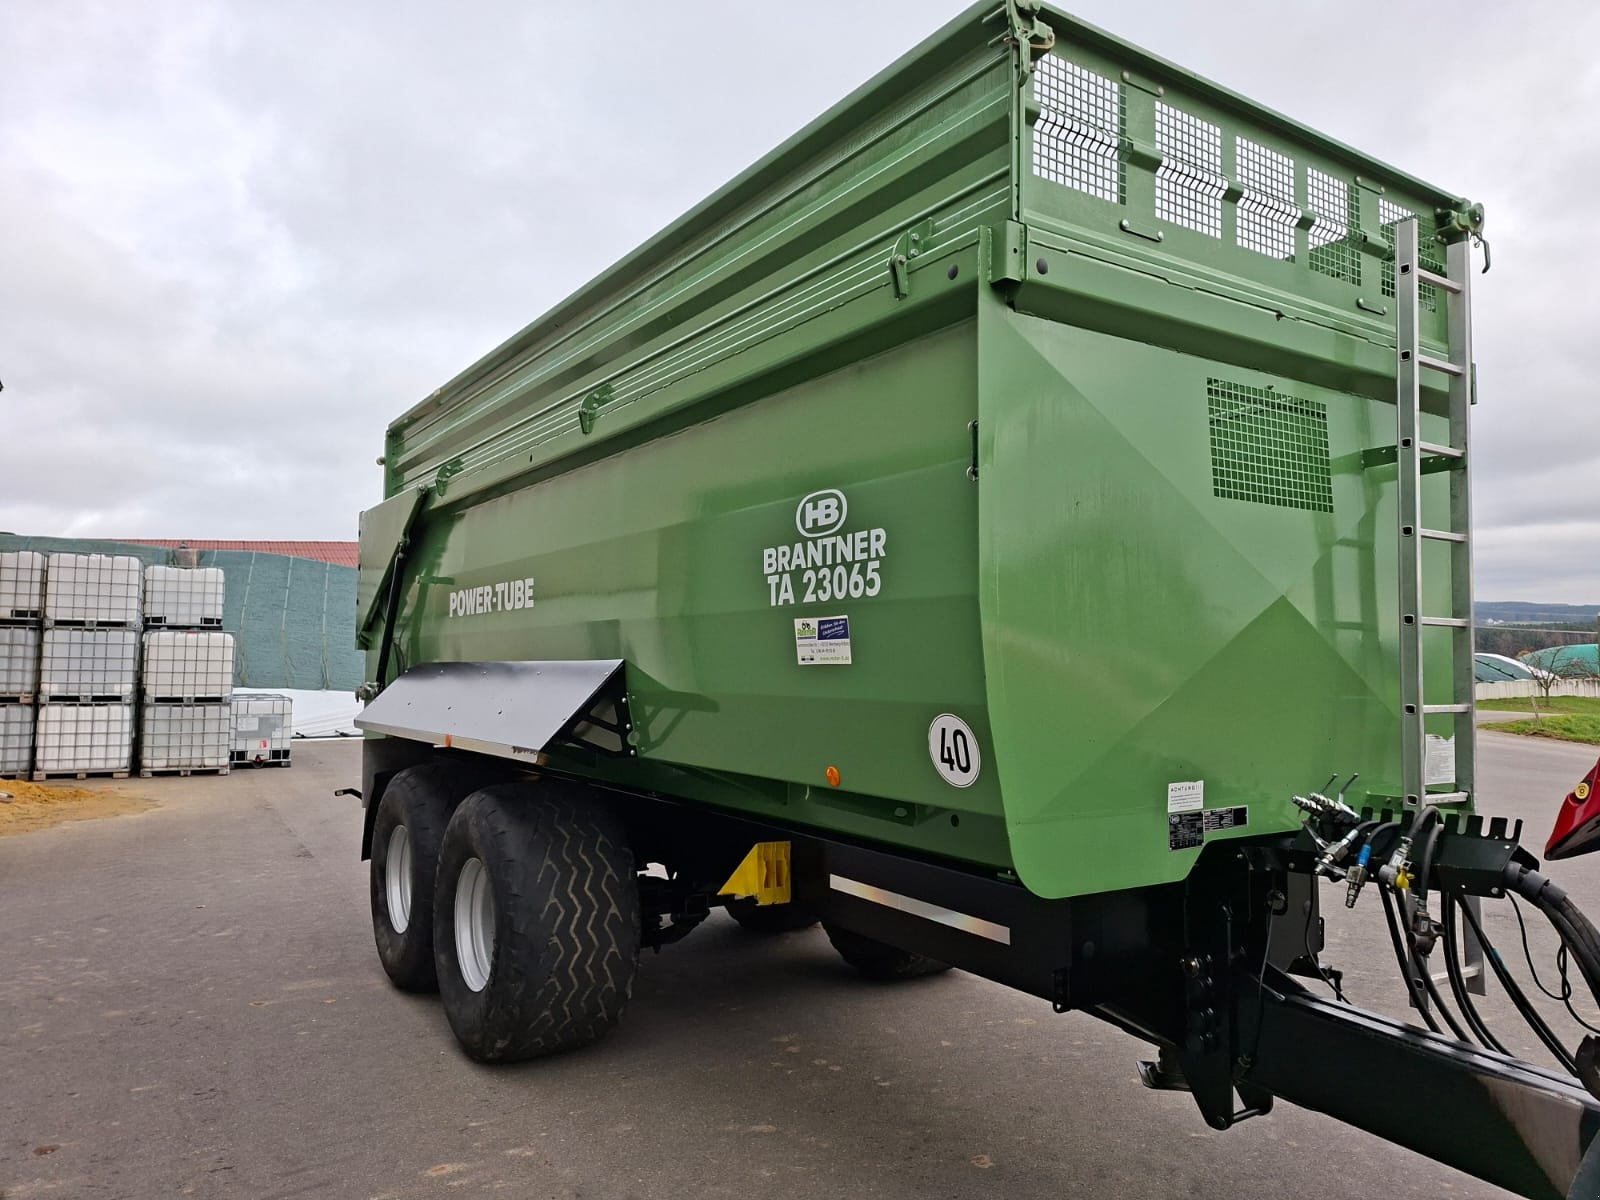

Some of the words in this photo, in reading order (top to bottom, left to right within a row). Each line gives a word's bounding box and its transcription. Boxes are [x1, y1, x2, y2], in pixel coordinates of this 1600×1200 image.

[805, 498, 840, 529] HB
[763, 527, 887, 575] BRANTNER
[449, 577, 535, 618] POWER-TUBE
[767, 573, 795, 607] TA
[802, 560, 881, 603] 23065
[940, 727, 971, 774] 40
